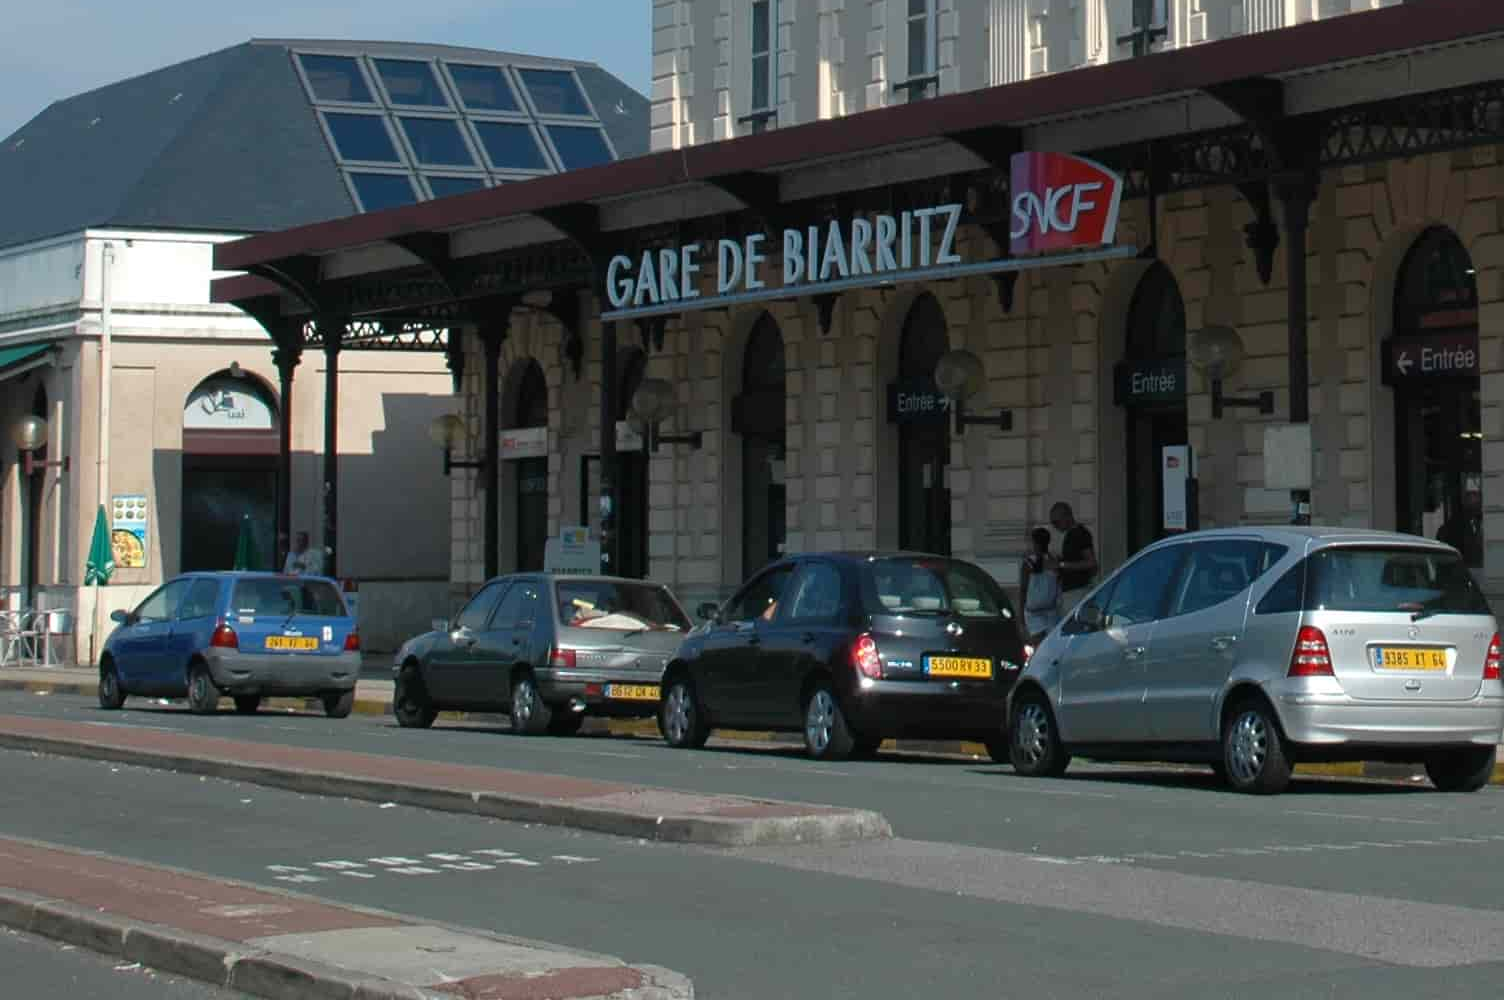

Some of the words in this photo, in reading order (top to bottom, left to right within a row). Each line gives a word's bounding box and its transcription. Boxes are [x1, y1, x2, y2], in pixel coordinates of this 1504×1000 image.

[1010, 182, 1103, 239] SNCF
[606, 244, 700, 308] GARE
[717, 232, 767, 294] DE
[783, 203, 963, 284] BIARRITZ
[1421, 344, 1475, 371] Entrée
[1131, 371, 1176, 393] Entrée
[898, 392, 934, 413] Entrée
[1384, 652, 1408, 664] 9385
[1432, 653, 1444, 665] 64
